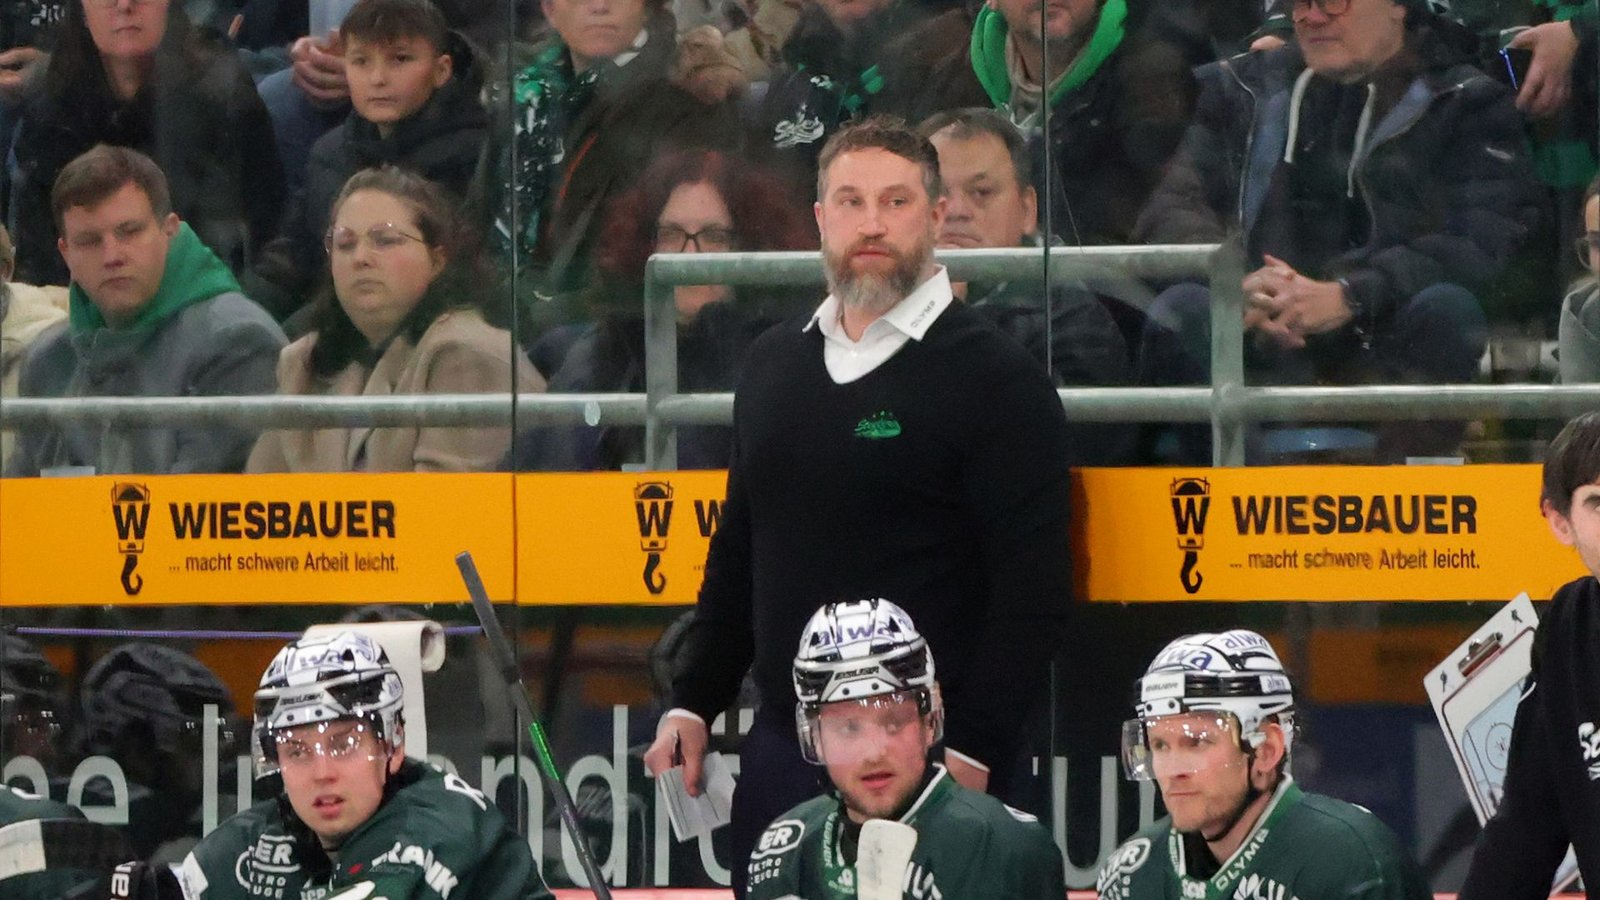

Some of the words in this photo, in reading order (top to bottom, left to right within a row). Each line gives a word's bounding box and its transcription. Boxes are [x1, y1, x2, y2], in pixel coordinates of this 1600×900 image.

[168, 500, 397, 539] WIESBAUER
[1231, 494, 1478, 536] WIESBAUER
[185, 553, 233, 572] macht
[236, 551, 300, 572] schwere
[303, 551, 350, 572] Arbeit
[1247, 549, 1298, 569] macht
[1303, 548, 1373, 570] schwere
[1378, 549, 1428, 570] Arbeit
[1215, 828, 1270, 891] OLYMP
